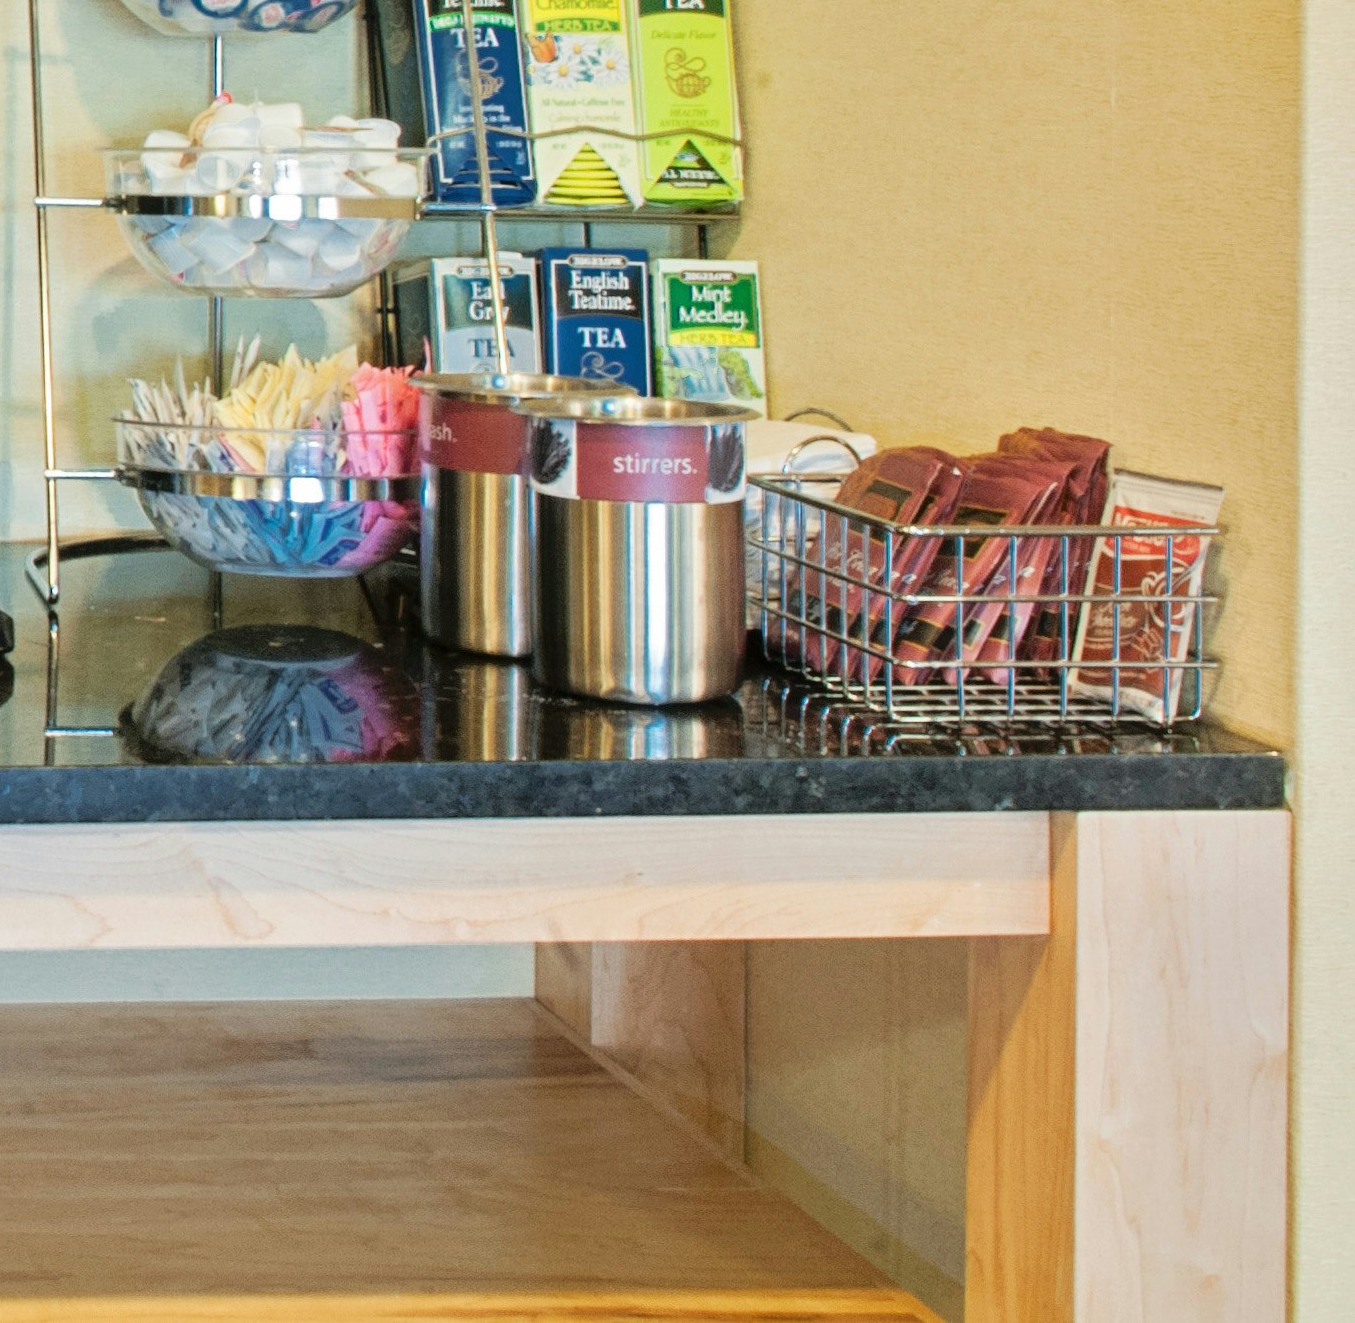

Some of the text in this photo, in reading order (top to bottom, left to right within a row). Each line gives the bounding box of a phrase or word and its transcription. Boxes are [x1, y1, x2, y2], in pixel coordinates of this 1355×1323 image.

[450, 28, 499, 48] TEA
[470, 280, 506, 300] Eal
[570, 269, 630, 293] English
[691, 285, 732, 302] Mint
[469, 300, 509, 321] Gry
[578, 327, 627, 348] TEA
[467, 338, 516, 358] TEA
[613, 452, 698, 475] stirrers.
